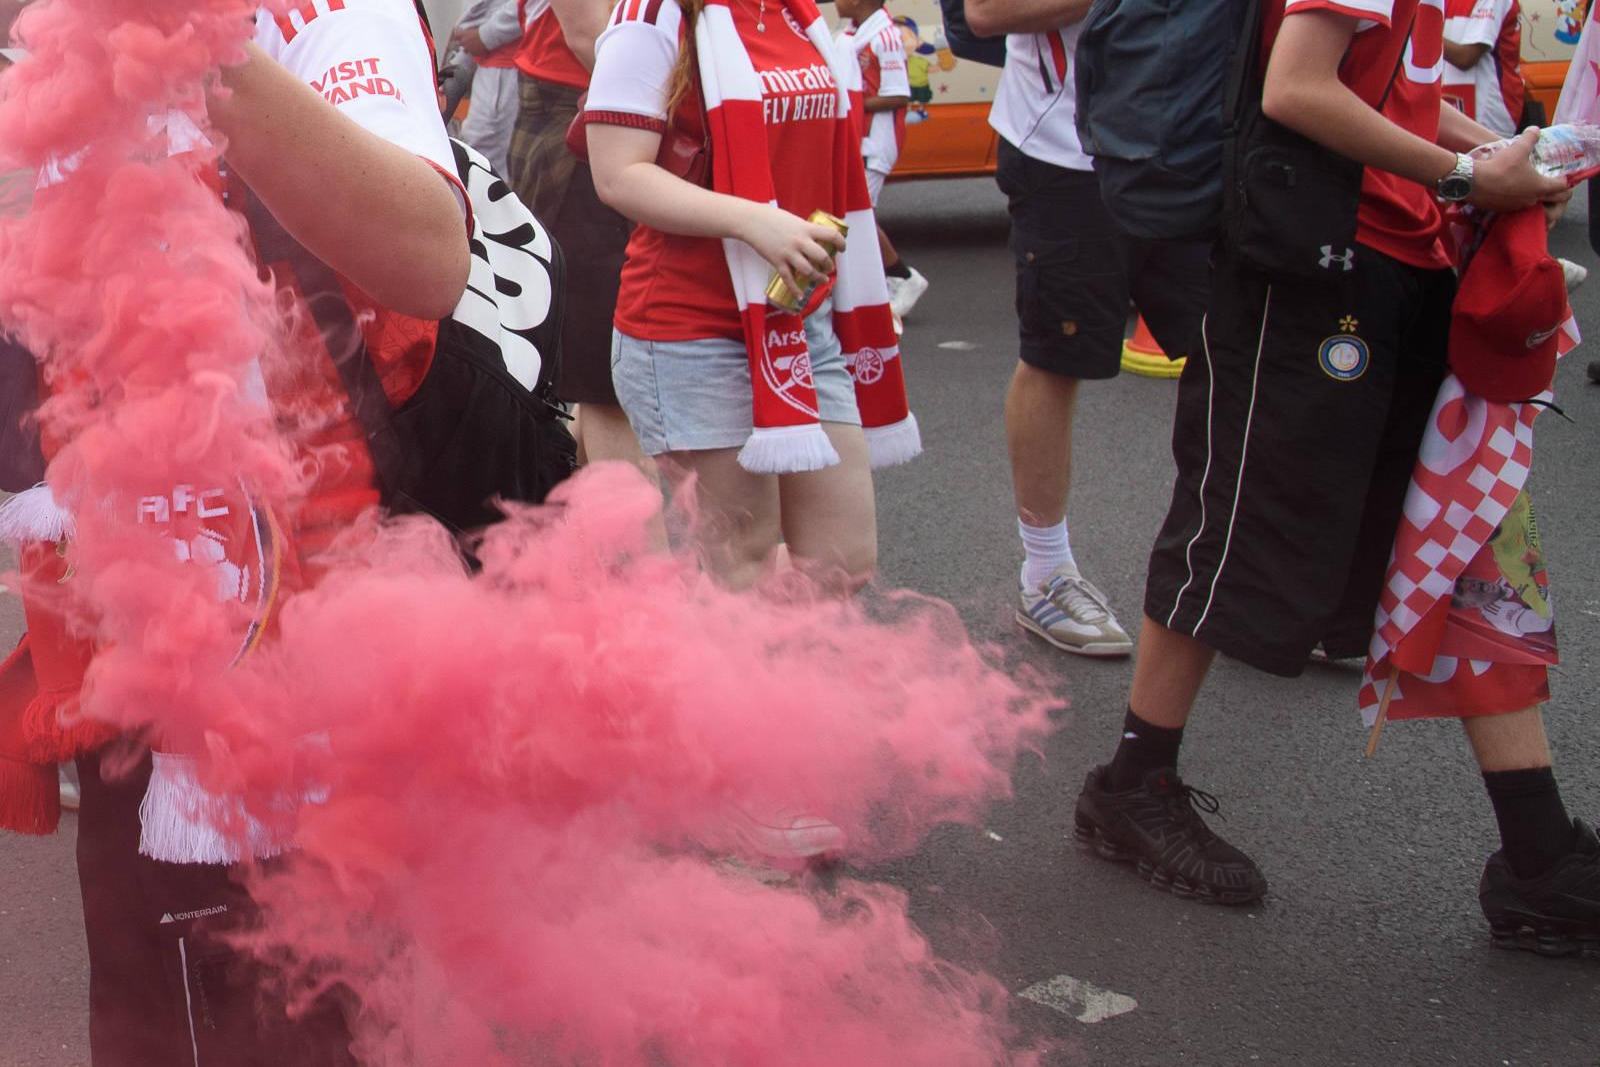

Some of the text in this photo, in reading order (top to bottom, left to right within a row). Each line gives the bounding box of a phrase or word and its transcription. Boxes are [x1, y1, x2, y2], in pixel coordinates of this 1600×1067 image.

[309, 57, 380, 93] VISIT
[759, 63, 835, 94] mirate
[763, 93, 835, 125] FLY BETTER
[137, 484, 229, 524] AFC
